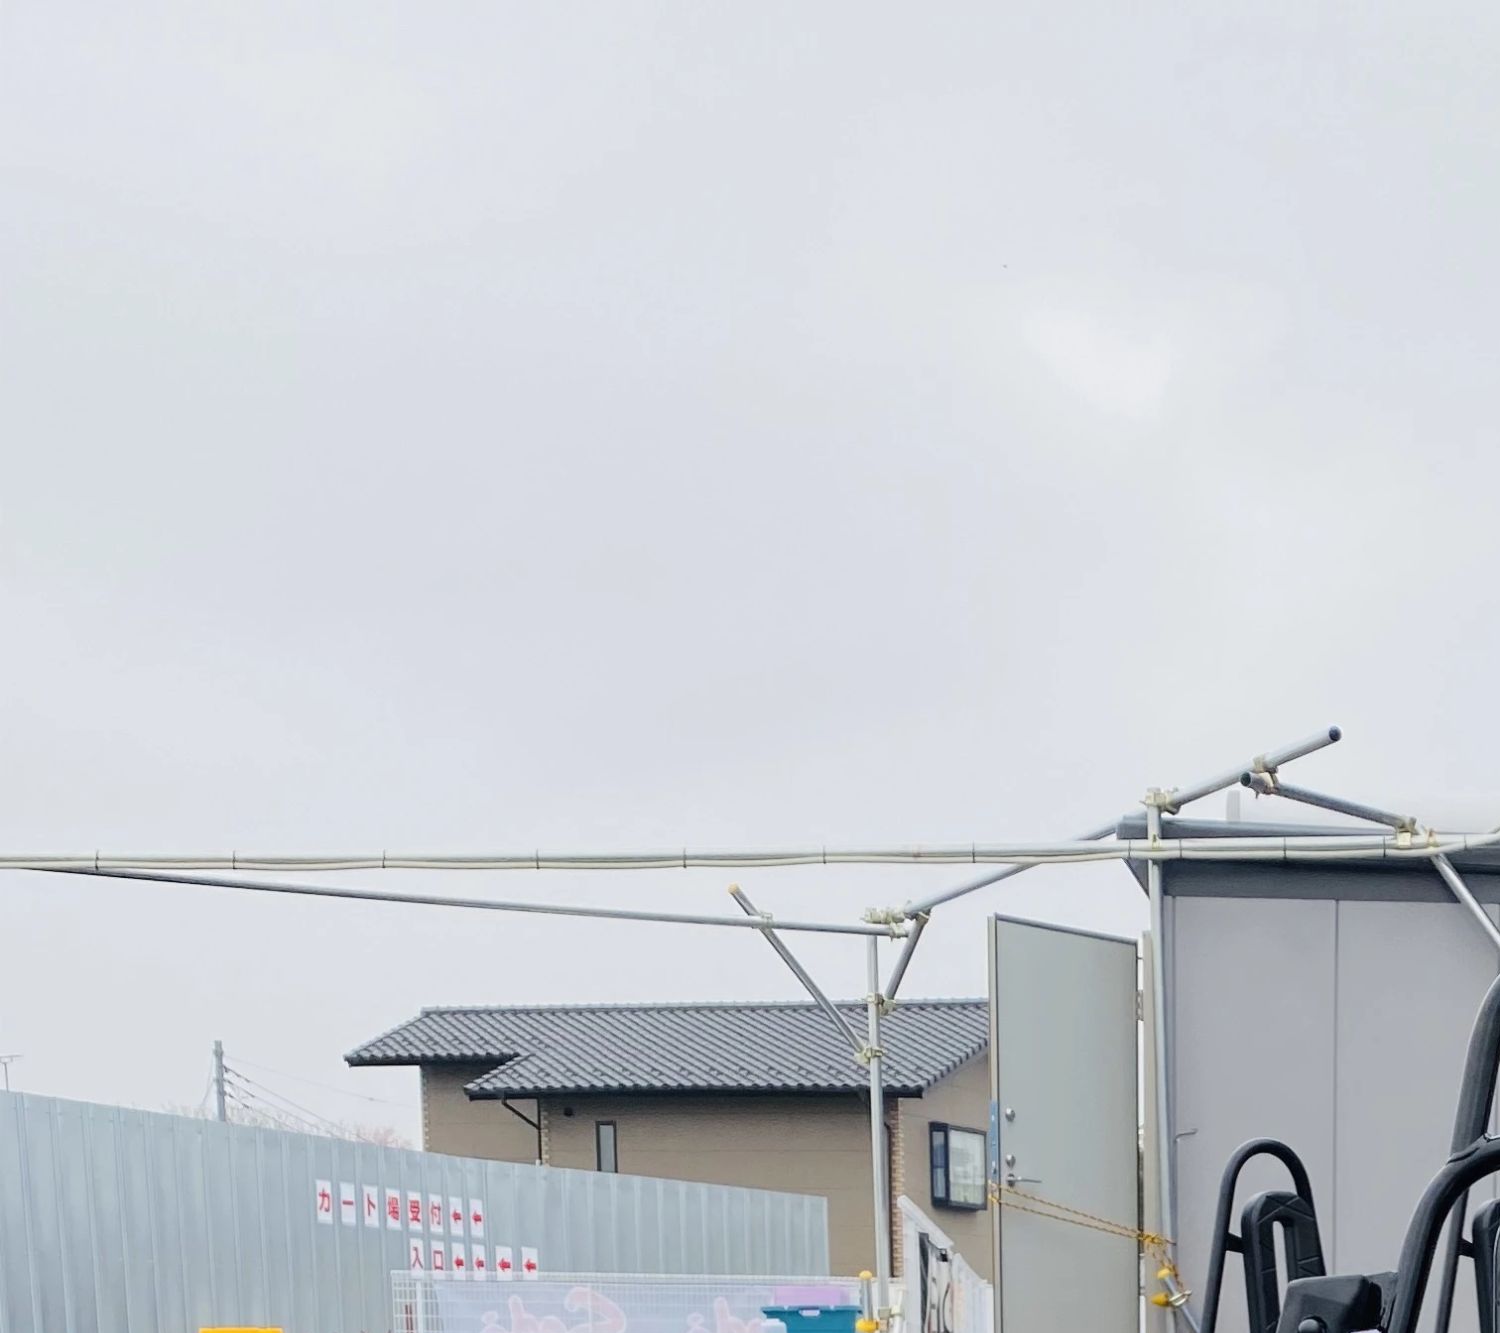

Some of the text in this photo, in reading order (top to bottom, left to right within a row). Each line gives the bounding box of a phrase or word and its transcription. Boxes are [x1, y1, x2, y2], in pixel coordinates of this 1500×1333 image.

[318, 1188, 441, 1225] カート場受付
[411, 1246, 444, 1271] 入口
